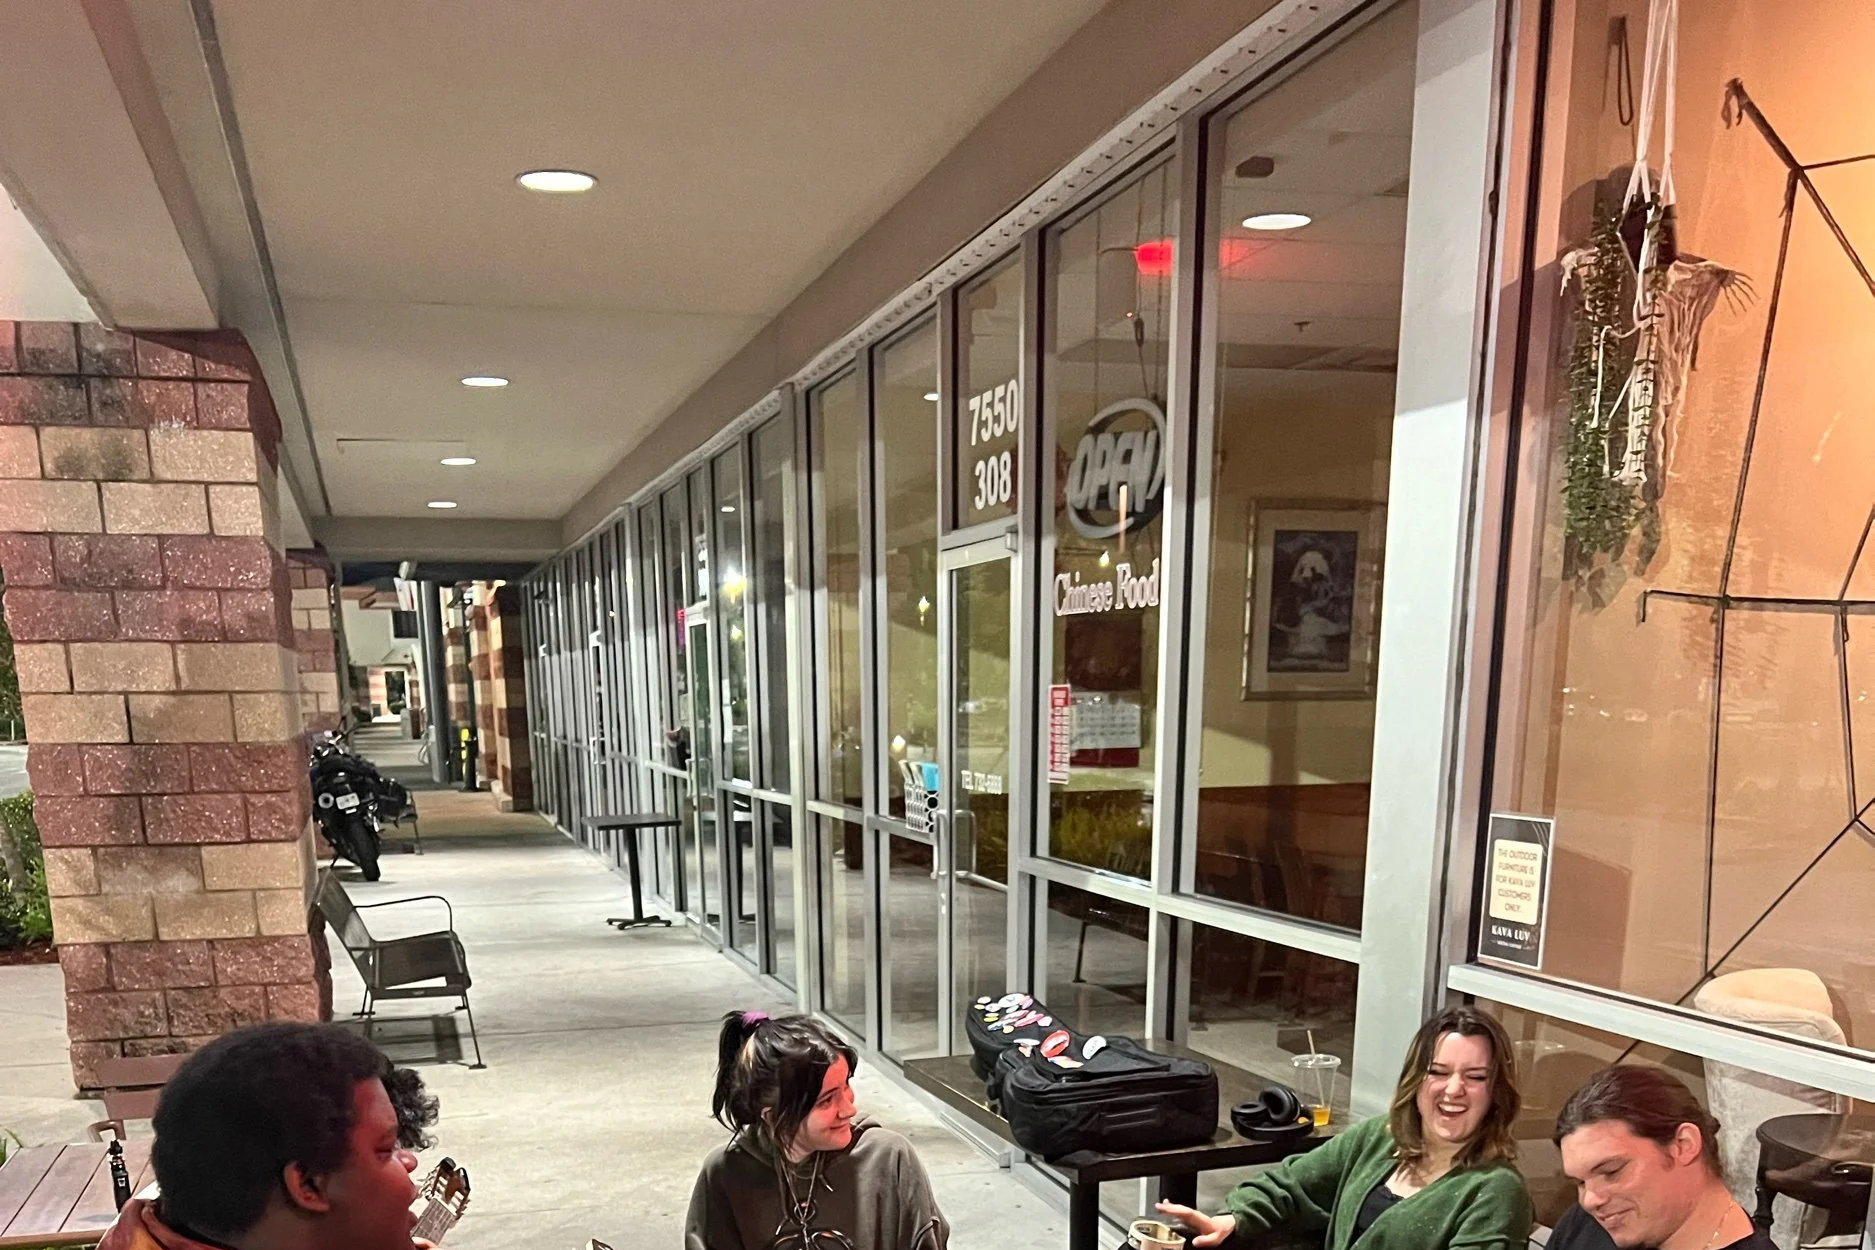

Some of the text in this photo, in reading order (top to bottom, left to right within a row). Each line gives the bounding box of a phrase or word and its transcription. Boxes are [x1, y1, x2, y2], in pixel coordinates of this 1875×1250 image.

[969, 379, 1018, 446] 7550
[974, 451, 1012, 510] 308
[1067, 429, 1158, 513] OPEN
[1055, 557, 1160, 617] Chinese Food
[1491, 925, 1531, 941] KAVA LUV
